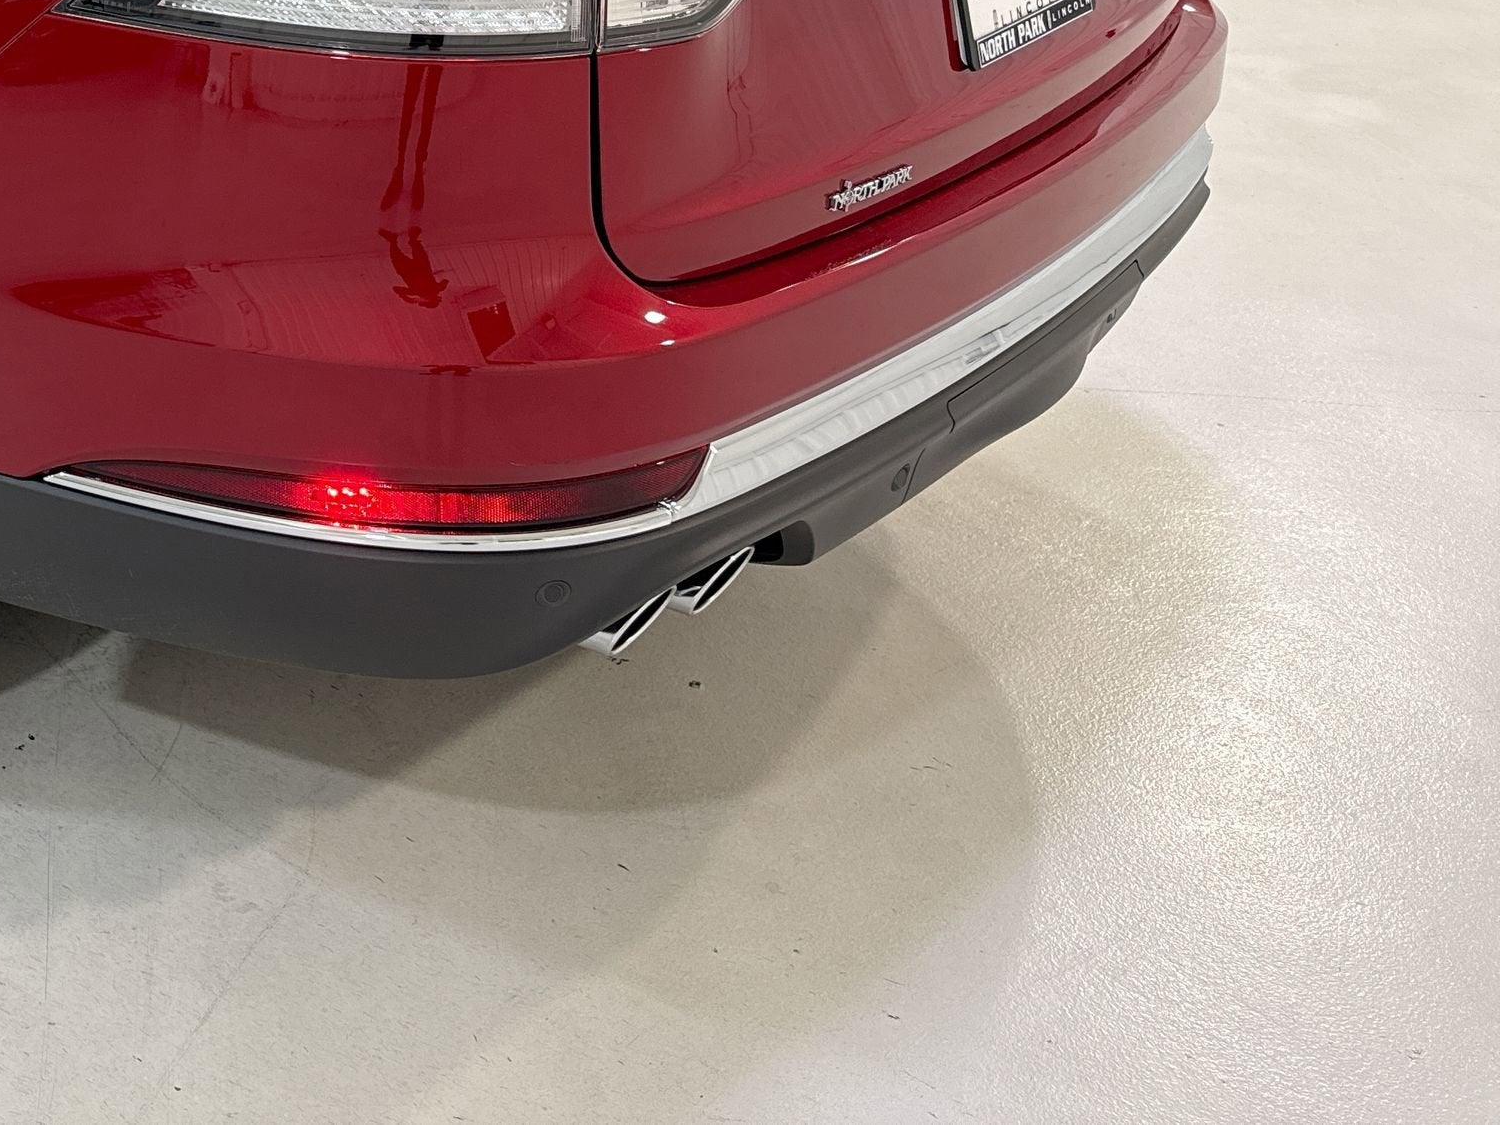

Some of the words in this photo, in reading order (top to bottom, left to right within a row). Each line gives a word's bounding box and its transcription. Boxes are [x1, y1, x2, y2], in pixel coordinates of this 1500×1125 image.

[980, 30, 1016, 63] NORTH
[1017, 12, 1047, 44] PARK
[829, 179, 881, 211] NORTH
[880, 165, 913, 192] PARK
